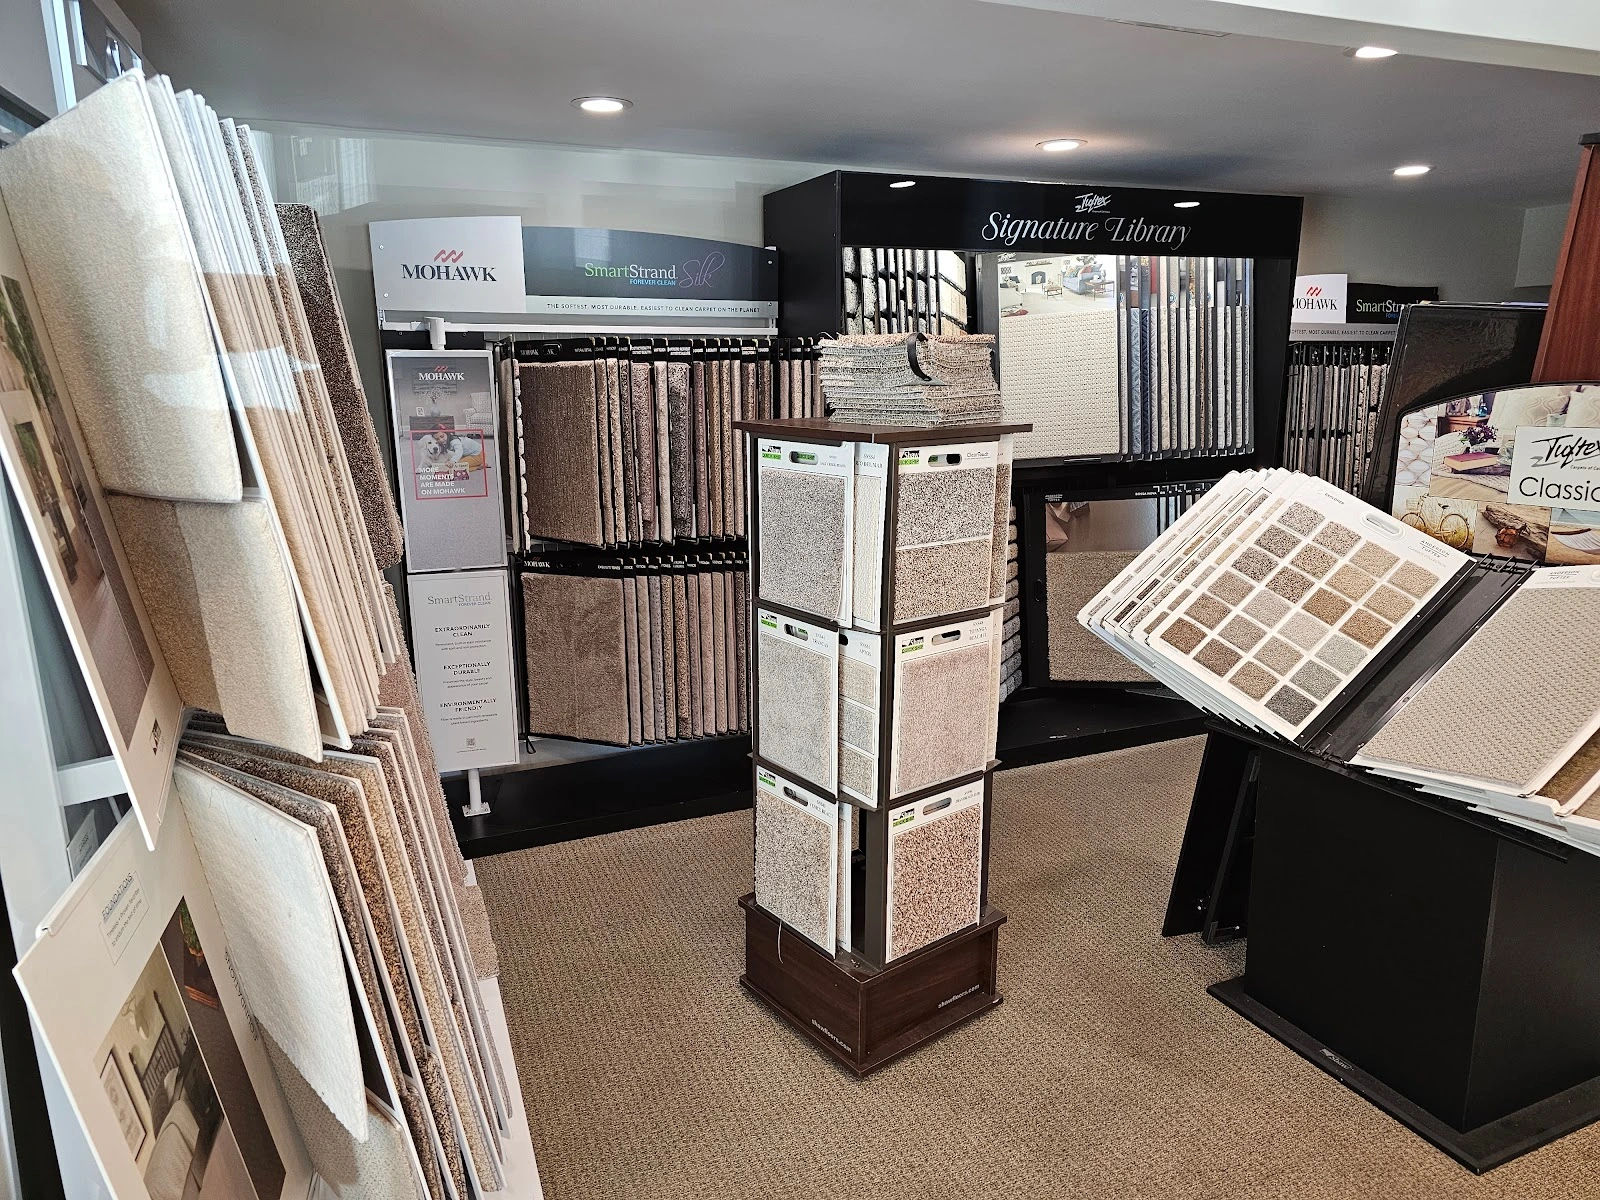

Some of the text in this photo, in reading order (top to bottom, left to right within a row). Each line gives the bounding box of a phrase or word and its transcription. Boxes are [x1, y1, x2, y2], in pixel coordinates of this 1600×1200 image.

[981, 211, 1192, 250] Signature Library
[401, 263, 497, 282] MOHAWK
[584, 250, 726, 289] SmartStrand Silk
[1356, 299, 1401, 312] SmartStr
[418, 372, 465, 381] MOHAWK
[427, 592, 492, 605] SmartStrand
[435, 623, 490, 633] EXTRAORDINARILY
[443, 661, 491, 670] EXCEPTIONALLY
[440, 698, 497, 708] ENVIRONMENTALLY
[102, 872, 132, 920] FOUNDATIONS
